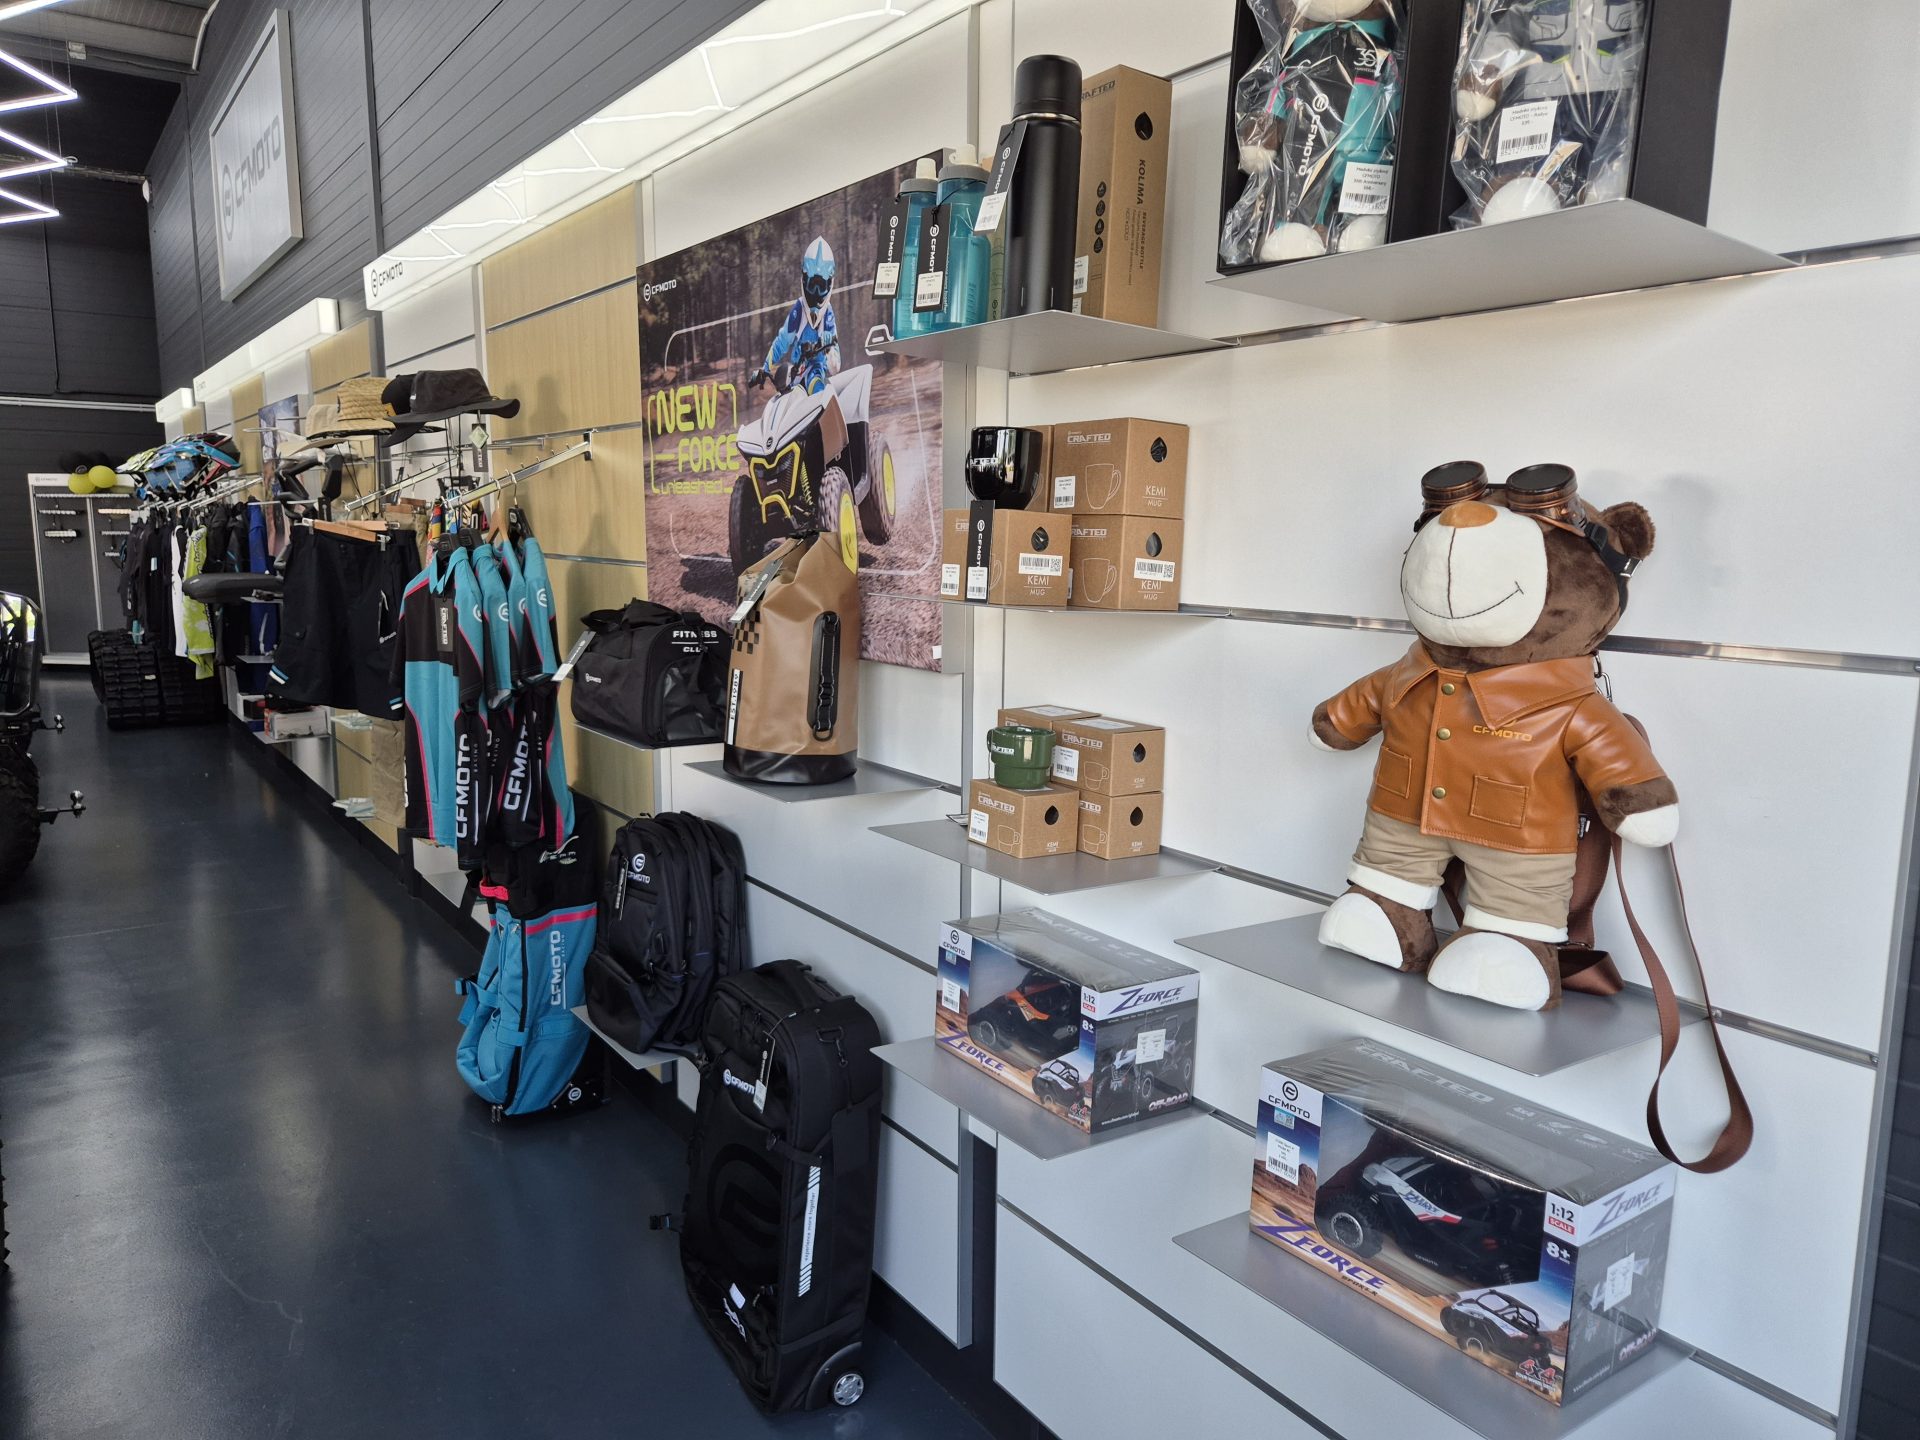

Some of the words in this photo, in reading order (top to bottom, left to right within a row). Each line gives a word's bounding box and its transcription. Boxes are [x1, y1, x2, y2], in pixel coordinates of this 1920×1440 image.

[1080, 79, 1116, 100] RAFTED
[1298, 115, 1321, 176] CFMOTO
[235, 115, 281, 208] CFMOTO
[994, 161, 1006, 194] CFMOT
[1136, 159, 1146, 205] KOLIMA
[887, 229, 896, 263] CFMOT
[929, 238, 937, 272] CFMOT
[378, 262, 404, 287] CFMOTO
[652, 279, 677, 295] CFMOTO
[656, 381, 718, 435] NEW
[1066, 432, 1112, 444] CRAFTED
[678, 433, 740, 473] FORCE
[970, 457, 999, 467] AFTED
[1145, 486, 1166, 497] KEMI
[1071, 528, 1108, 537] RAFTED
[1027, 575, 1049, 586] KEMI
[1141, 580, 1162, 590] KEMI
[1061, 733, 1103, 749] CRAFTED
[1472, 724, 1533, 742] CFMOTO
[503, 723, 530, 811] CFMOT
[456, 733, 471, 838] CFMOTO
[977, 795, 1016, 813] CRAFTED
[943, 941, 966, 956] CFMOTO
[550, 930, 562, 1006] CFMOTO
[1083, 992, 1096, 1004] 1:12
[1082, 1019, 1094, 1031] 8+
[731, 1076, 755, 1095] CFMOT
[1268, 1094, 1311, 1119] CFMOTO
[1551, 1203, 1574, 1223] 1:12
[1549, 1219, 1574, 1235] SCALE
[1546, 1241, 1570, 1258] 8+
